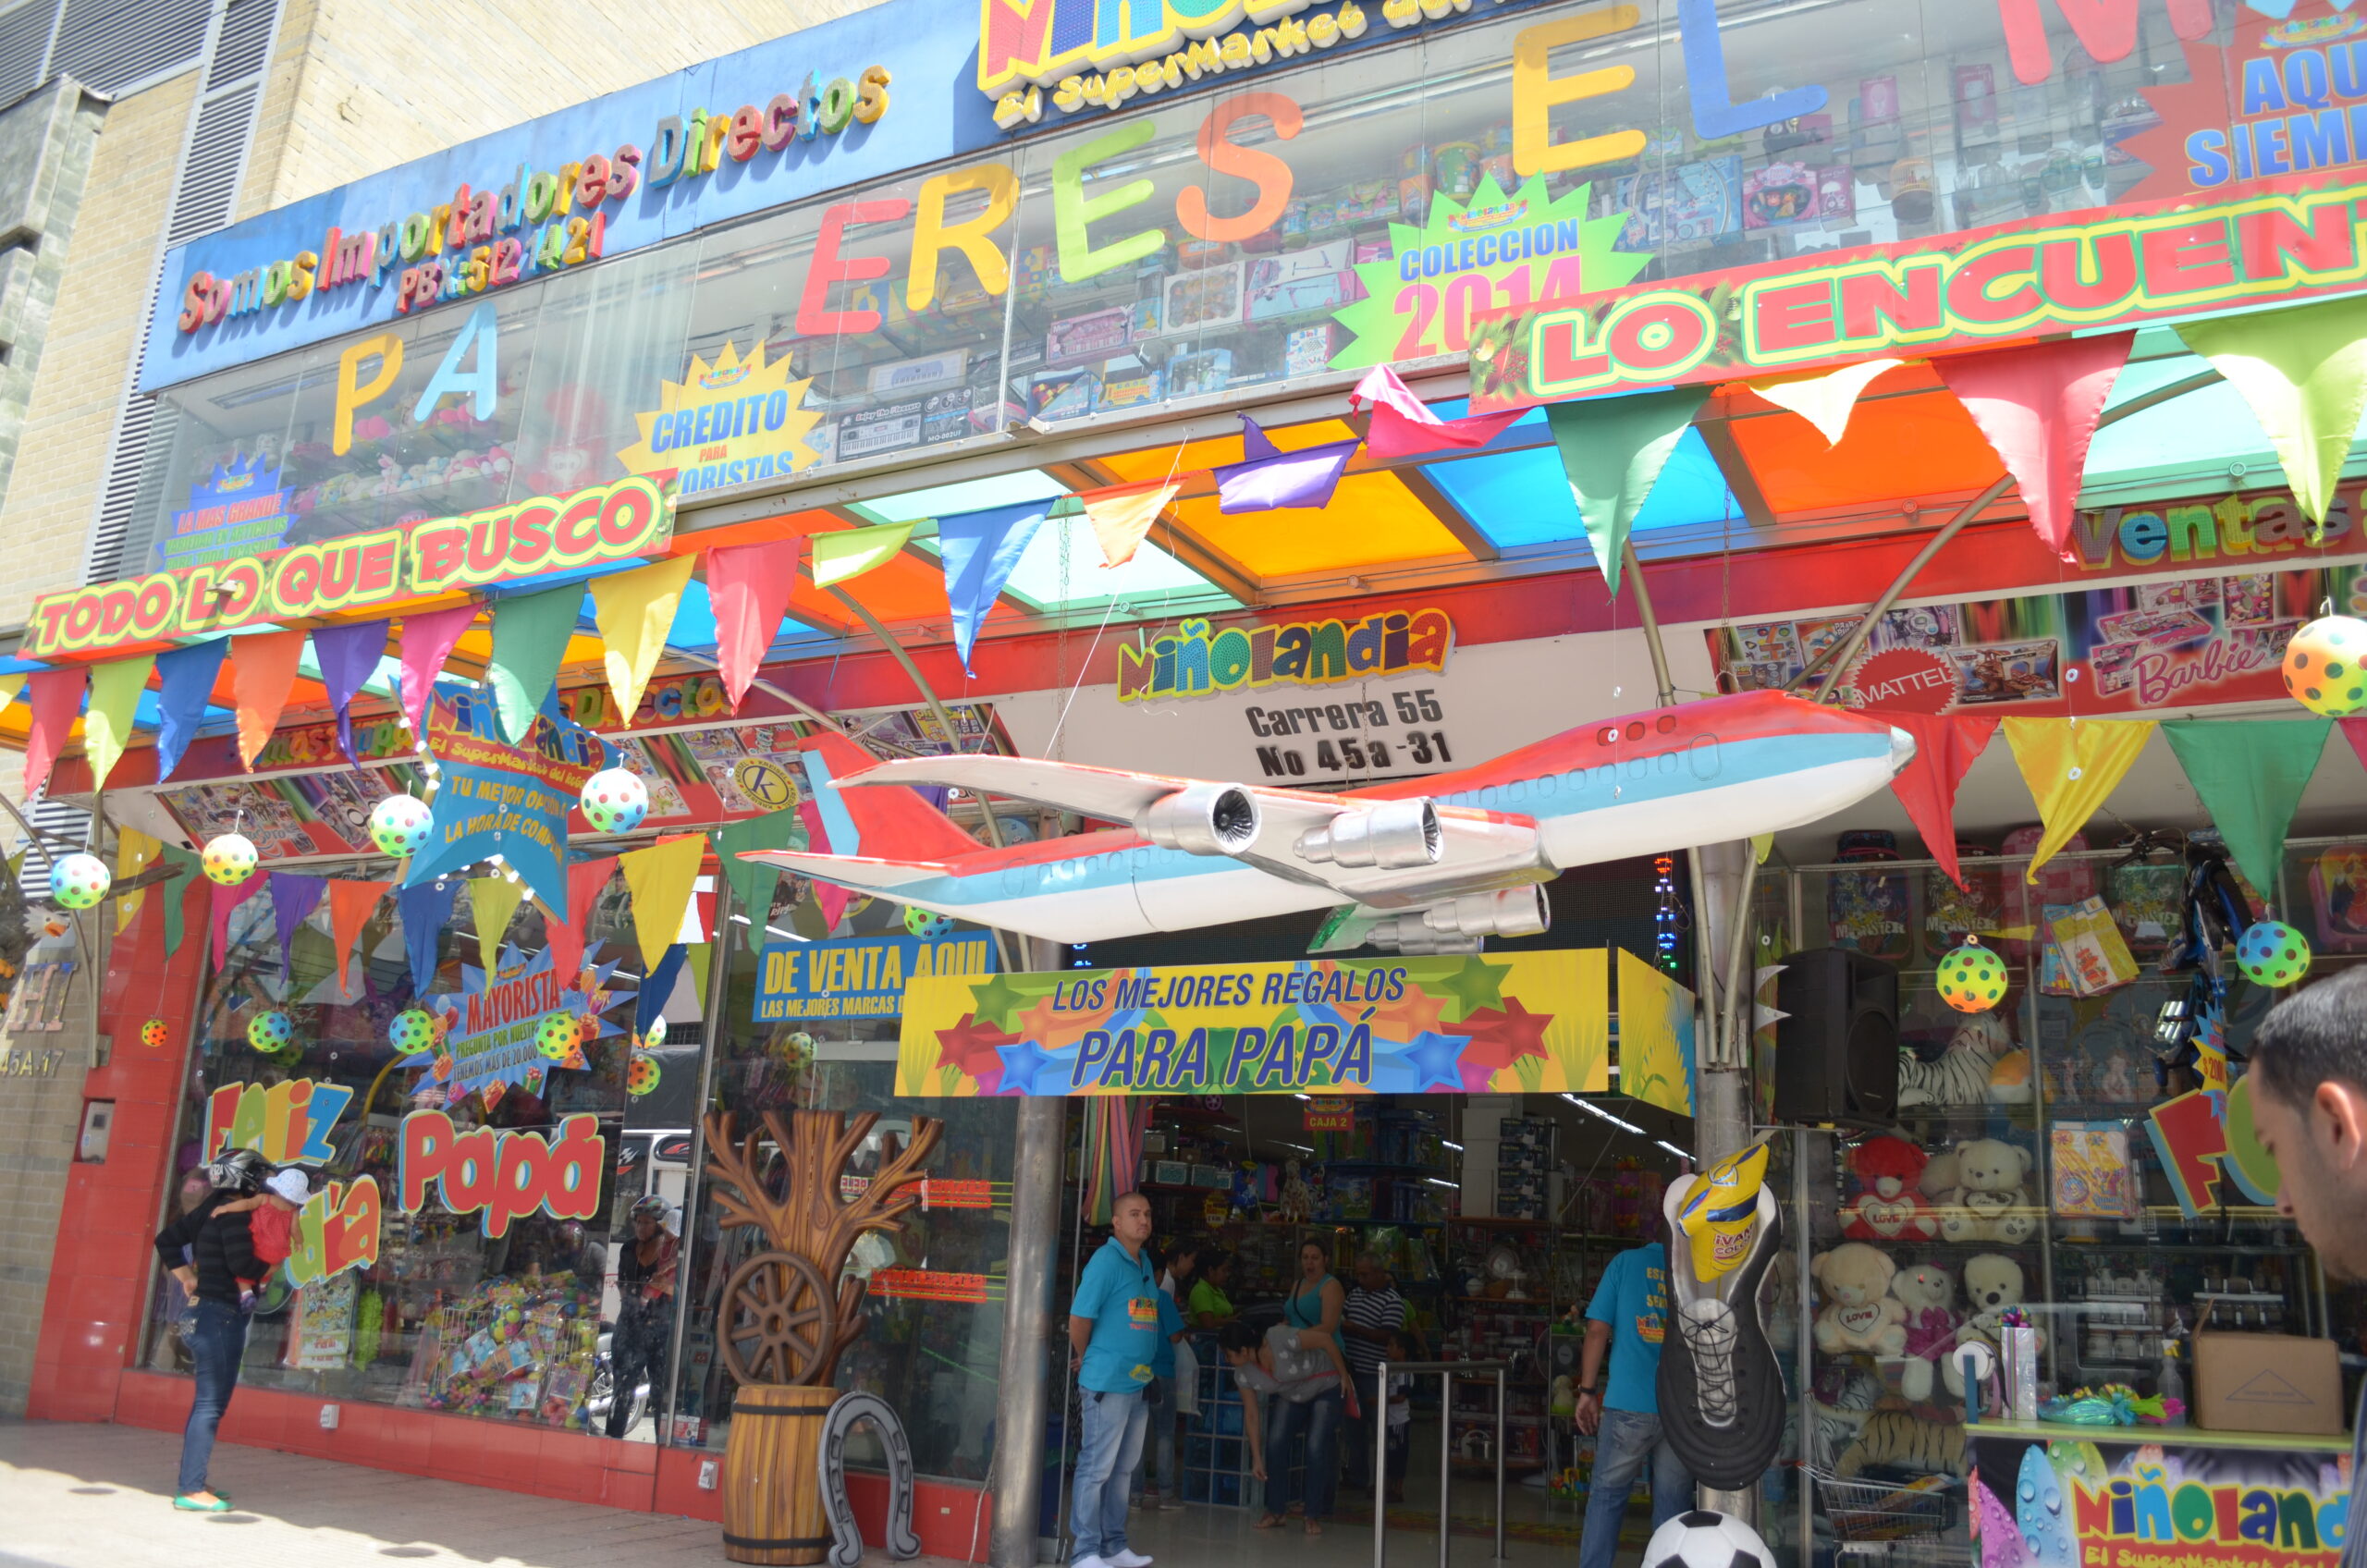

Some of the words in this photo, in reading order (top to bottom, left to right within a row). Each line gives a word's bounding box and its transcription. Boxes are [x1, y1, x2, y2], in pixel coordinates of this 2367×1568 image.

[2241, 39, 2367, 116] AQU
[795, 92, 1304, 336] ERES
[1513, 0, 1828, 177] EL
[179, 251, 318, 333] Somos
[316, 144, 644, 291] Importadores
[648, 65, 892, 188] Directos
[1399, 217, 1578, 281] COLECCION
[1528, 290, 1719, 397] LO
[1741, 185, 2367, 366] ENCUEN
[651, 389, 788, 453] CREDITO
[677, 450, 793, 495] ORISTAS
[699, 445, 728, 462] PARA
[178, 510, 194, 534] LA
[194, 506, 227, 532] MAS
[227, 493, 284, 524] GRANDE
[36, 574, 179, 653] TODO
[179, 557, 265, 632] LO
[271, 531, 404, 618] QUE
[411, 474, 662, 594] BUSCO
[1117, 607, 1453, 703] Niñolandia
[2130, 639, 2265, 704] Barbie
[1854, 667, 1956, 704] MATTEL
[1245, 700, 1390, 738] Carrera
[1392, 689, 1443, 724] 55
[1256, 746, 1306, 777] No
[1317, 737, 1392, 771] 45a
[451, 776, 473, 796] TU
[476, 780, 525, 807] MEJOR
[751, 766, 775, 802] K
[445, 820, 463, 843] LA
[467, 813, 503, 836] HORA
[503, 813, 520, 831] DE
[764, 951, 801, 995] DE
[809, 946, 901, 993] VENTA
[1052, 979, 1108, 1012] LOS
[1113, 973, 1254, 1011] MEJORES
[1261, 967, 1407, 1006] REGALOS
[466, 968, 561, 1035] MAYORISTA
[761, 1000, 784, 1018] LAS
[786, 998, 840, 1017] MEJORES
[841, 996, 895, 1015] MARCAS
[456, 1036, 492, 1060] PREGUNTA
[493, 1031, 509, 1047] POR
[509, 1020, 540, 1043] NUESTR
[1070, 1026, 1208, 1088] PARA
[1223, 1006, 1377, 1086] PAPÁ
[453, 1062, 484, 1083] TENEMOS
[484, 1057, 501, 1073] MAS
[502, 1053, 512, 1070] DE
[1309, 1117, 1337, 1128] CAJA
[1340, 1117, 1347, 1127] 2
[399, 1109, 606, 1239] Papá
[1872, 1213, 1900, 1224] LOVE
[1846, 1311, 1872, 1322] LOVE
[2072, 1464, 2350, 1553] Niñoland
[2084, 1545, 2110, 1566] El
